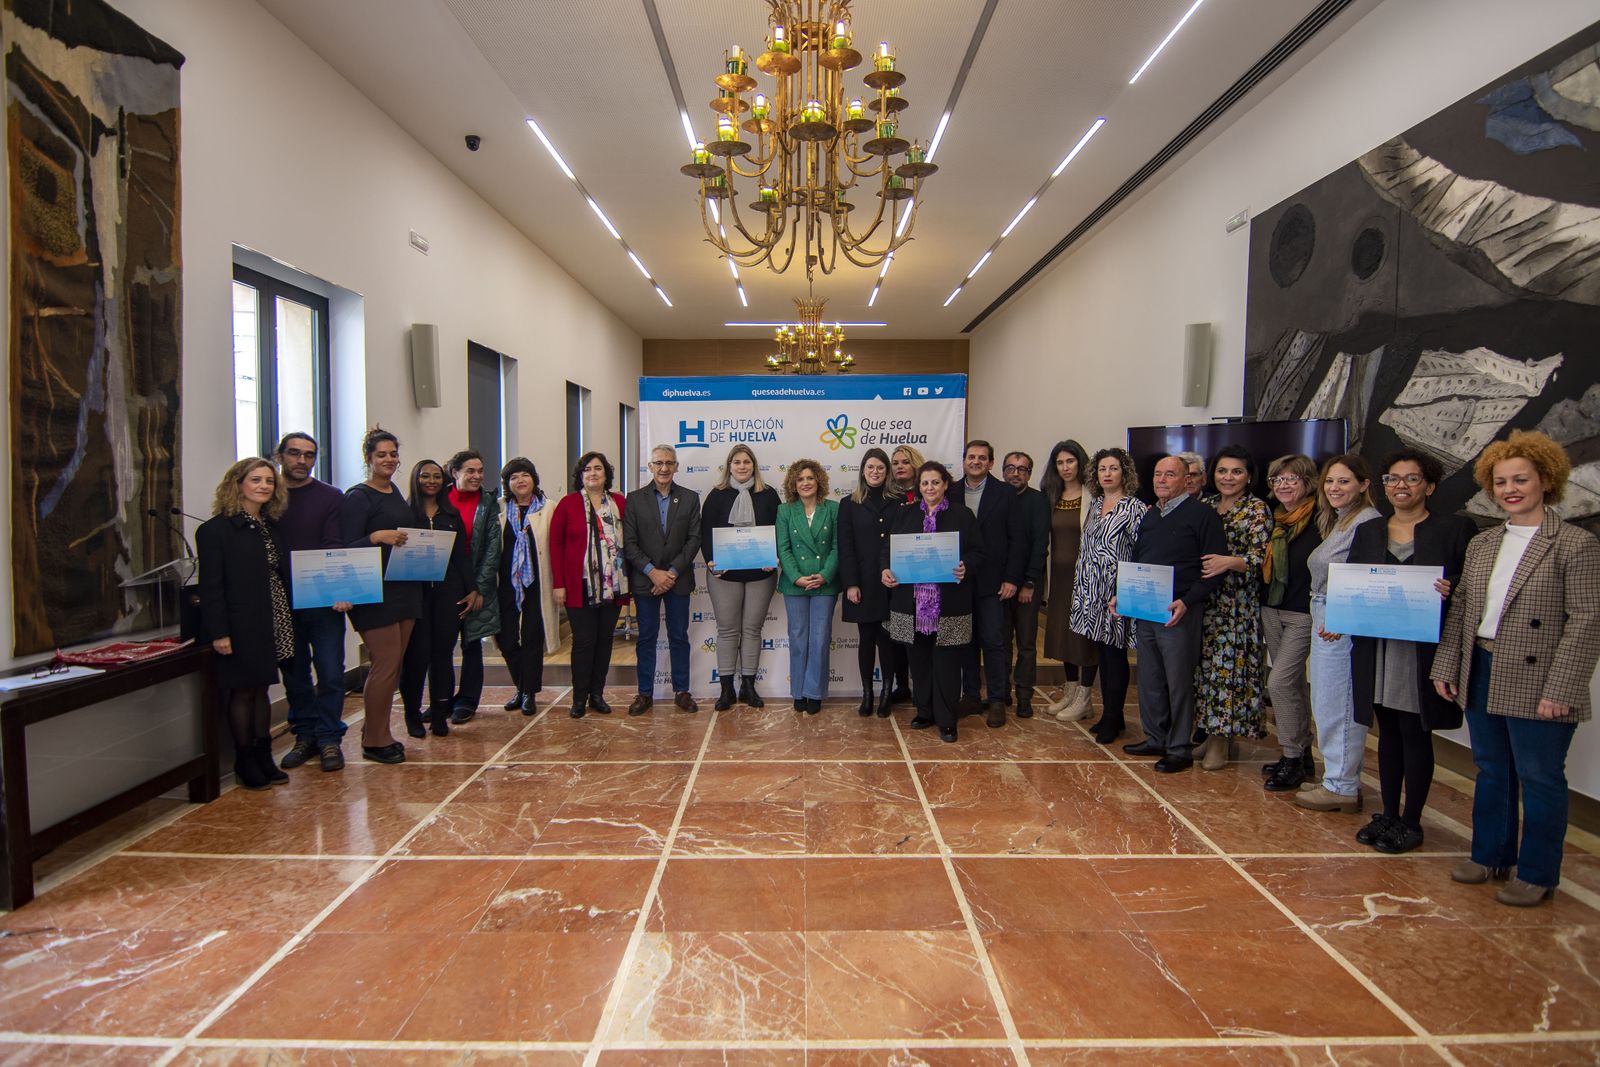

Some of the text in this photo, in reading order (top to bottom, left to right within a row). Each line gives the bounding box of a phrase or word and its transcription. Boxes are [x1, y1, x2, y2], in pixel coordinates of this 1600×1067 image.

[662, 388, 712, 398] diphuelva.es
[751, 387, 826, 397] queseadehuelva.es
[710, 417, 784, 430] DIPUTACIÓN
[860, 418, 912, 431] Que sea
[710, 431, 777, 443] DE HUELVA
[860, 432, 928, 445] de Huelva
